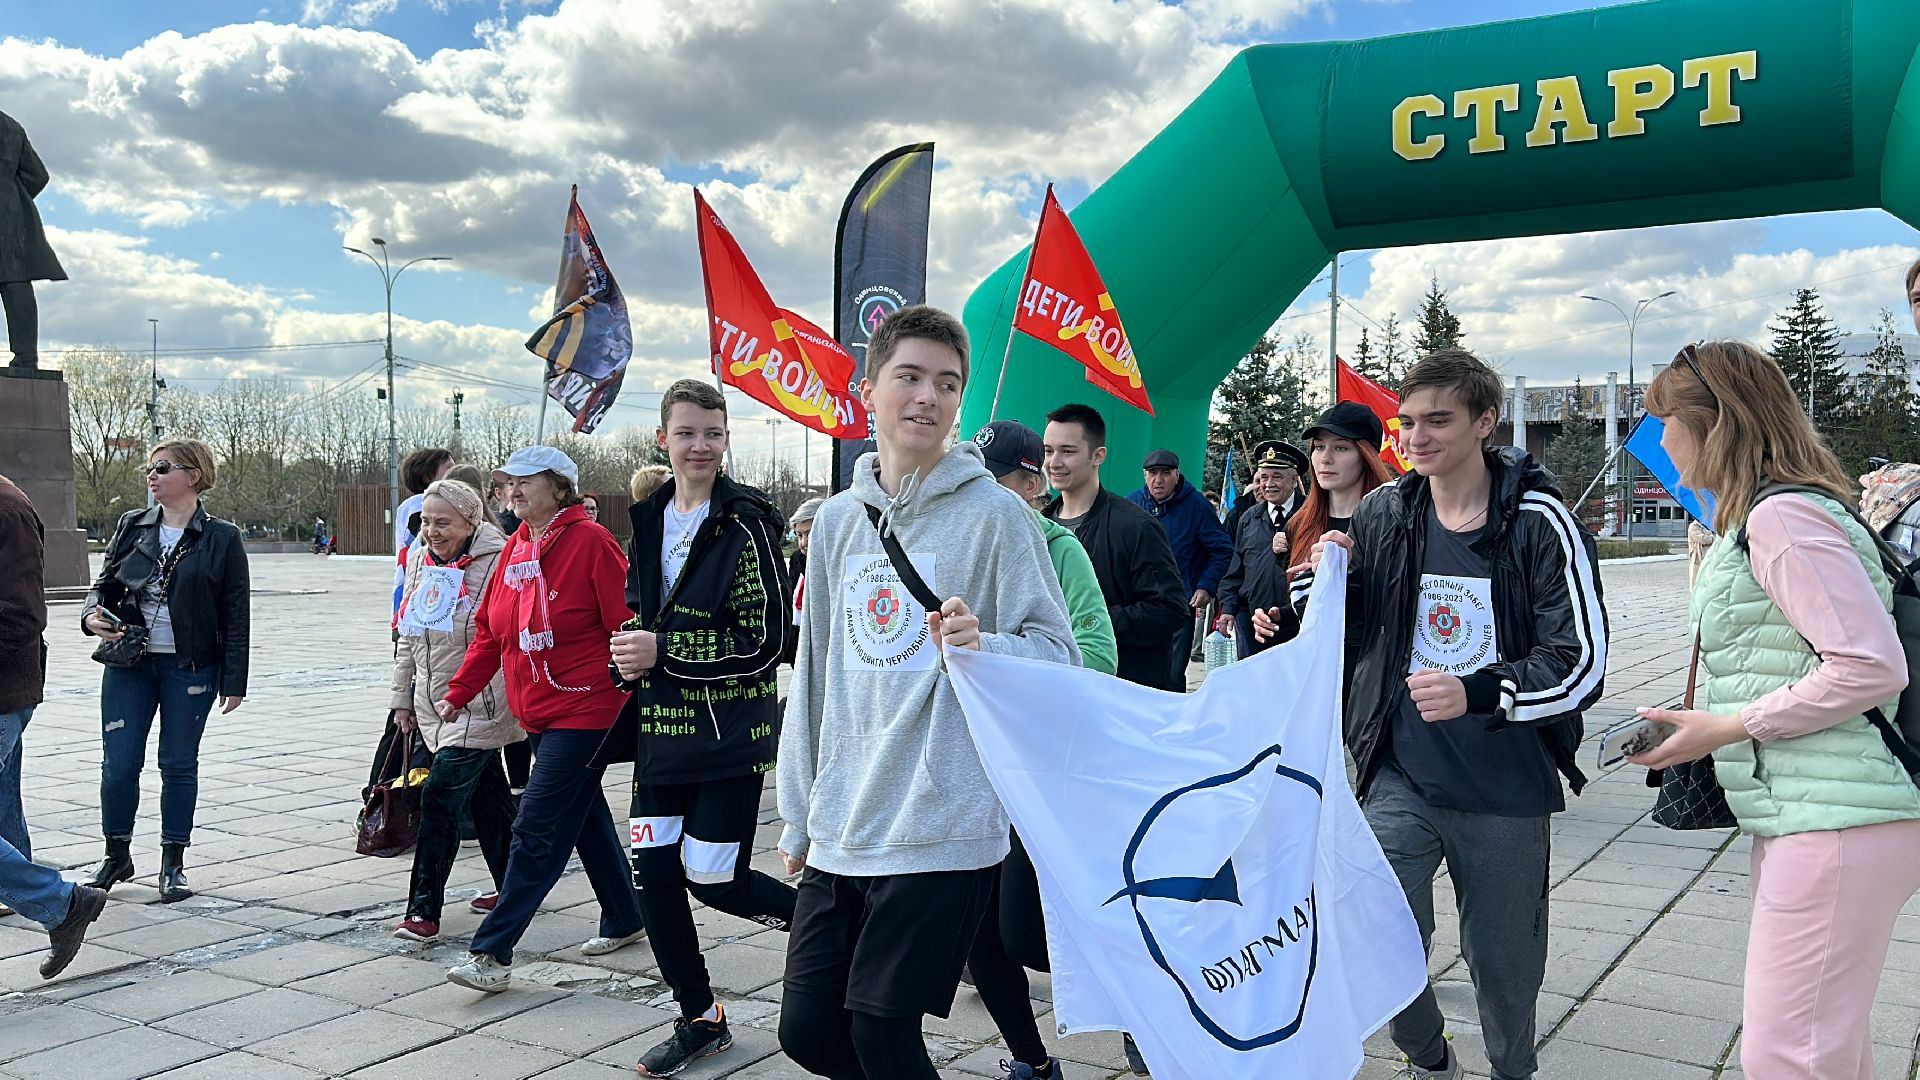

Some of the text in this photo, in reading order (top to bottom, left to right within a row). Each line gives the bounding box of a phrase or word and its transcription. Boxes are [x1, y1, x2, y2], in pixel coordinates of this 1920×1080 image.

[1391, 50, 1757, 161] СТАРТ
[1022, 278, 1085, 332] ДЕТИ
[714, 315, 760, 367] ТИ
[858, 558, 892, 579] ЕЖЕГОД
[1423, 592, 1463, 603] 1986-2023
[1463, 589, 1485, 612] ЗАБЕГ
[1412, 624, 1492, 673] ПОДВИГА ЧЕРНОБЫЛЬЦЕВ
[653, 703, 696, 719] Angels
[653, 720, 697, 737] Angels
[1200, 897, 1311, 993] ФЛАГМА
